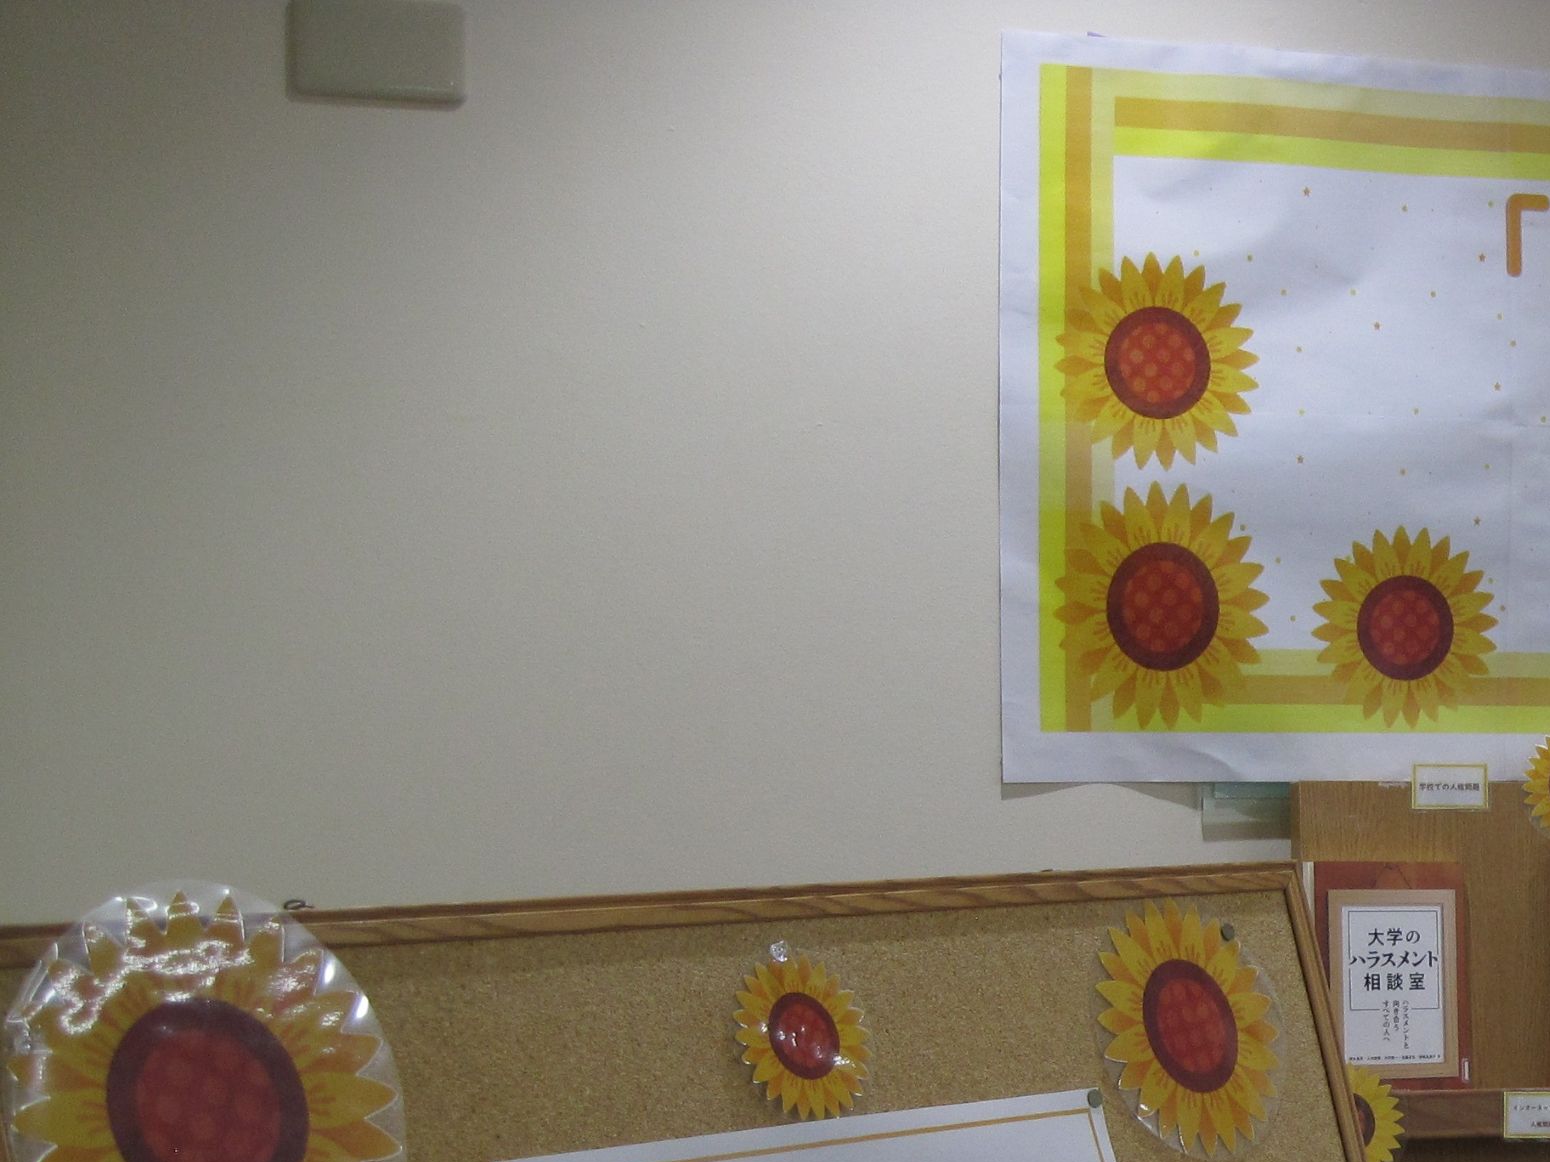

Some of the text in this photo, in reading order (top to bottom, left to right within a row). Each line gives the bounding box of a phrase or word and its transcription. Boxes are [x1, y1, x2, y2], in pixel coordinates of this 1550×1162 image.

[1418, 781, 1481, 793] 学校での人権問題
[1367, 928, 1421, 948] 大学の
[1350, 950, 1438, 969] ハラスメント
[1363, 972, 1427, 992] 相談室
[1381, 999, 1391, 1042] すべての人へ
[1391, 999, 1400, 1034] 向き合う
